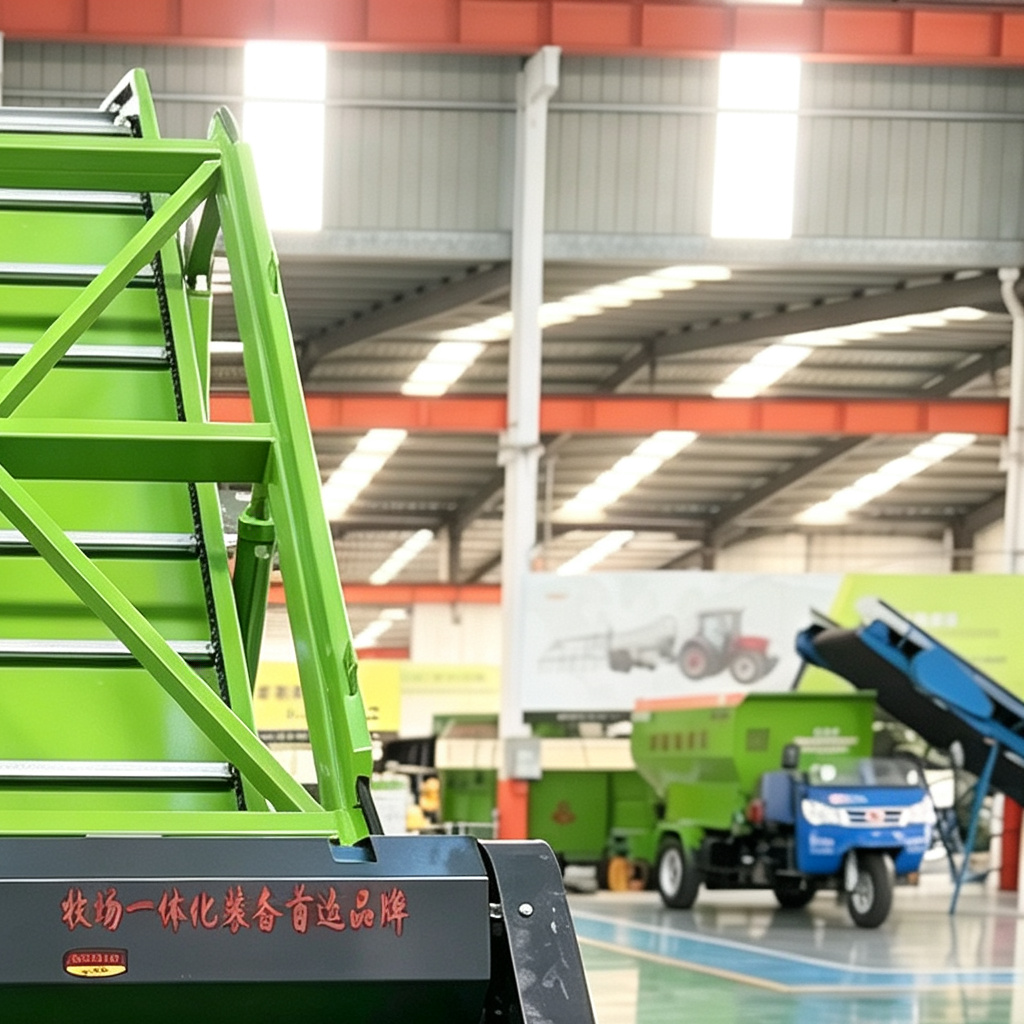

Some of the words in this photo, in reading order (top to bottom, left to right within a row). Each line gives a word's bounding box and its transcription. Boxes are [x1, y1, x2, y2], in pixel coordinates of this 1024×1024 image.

[60, 883, 411, 937] 牧场一体化装备首选品牌
